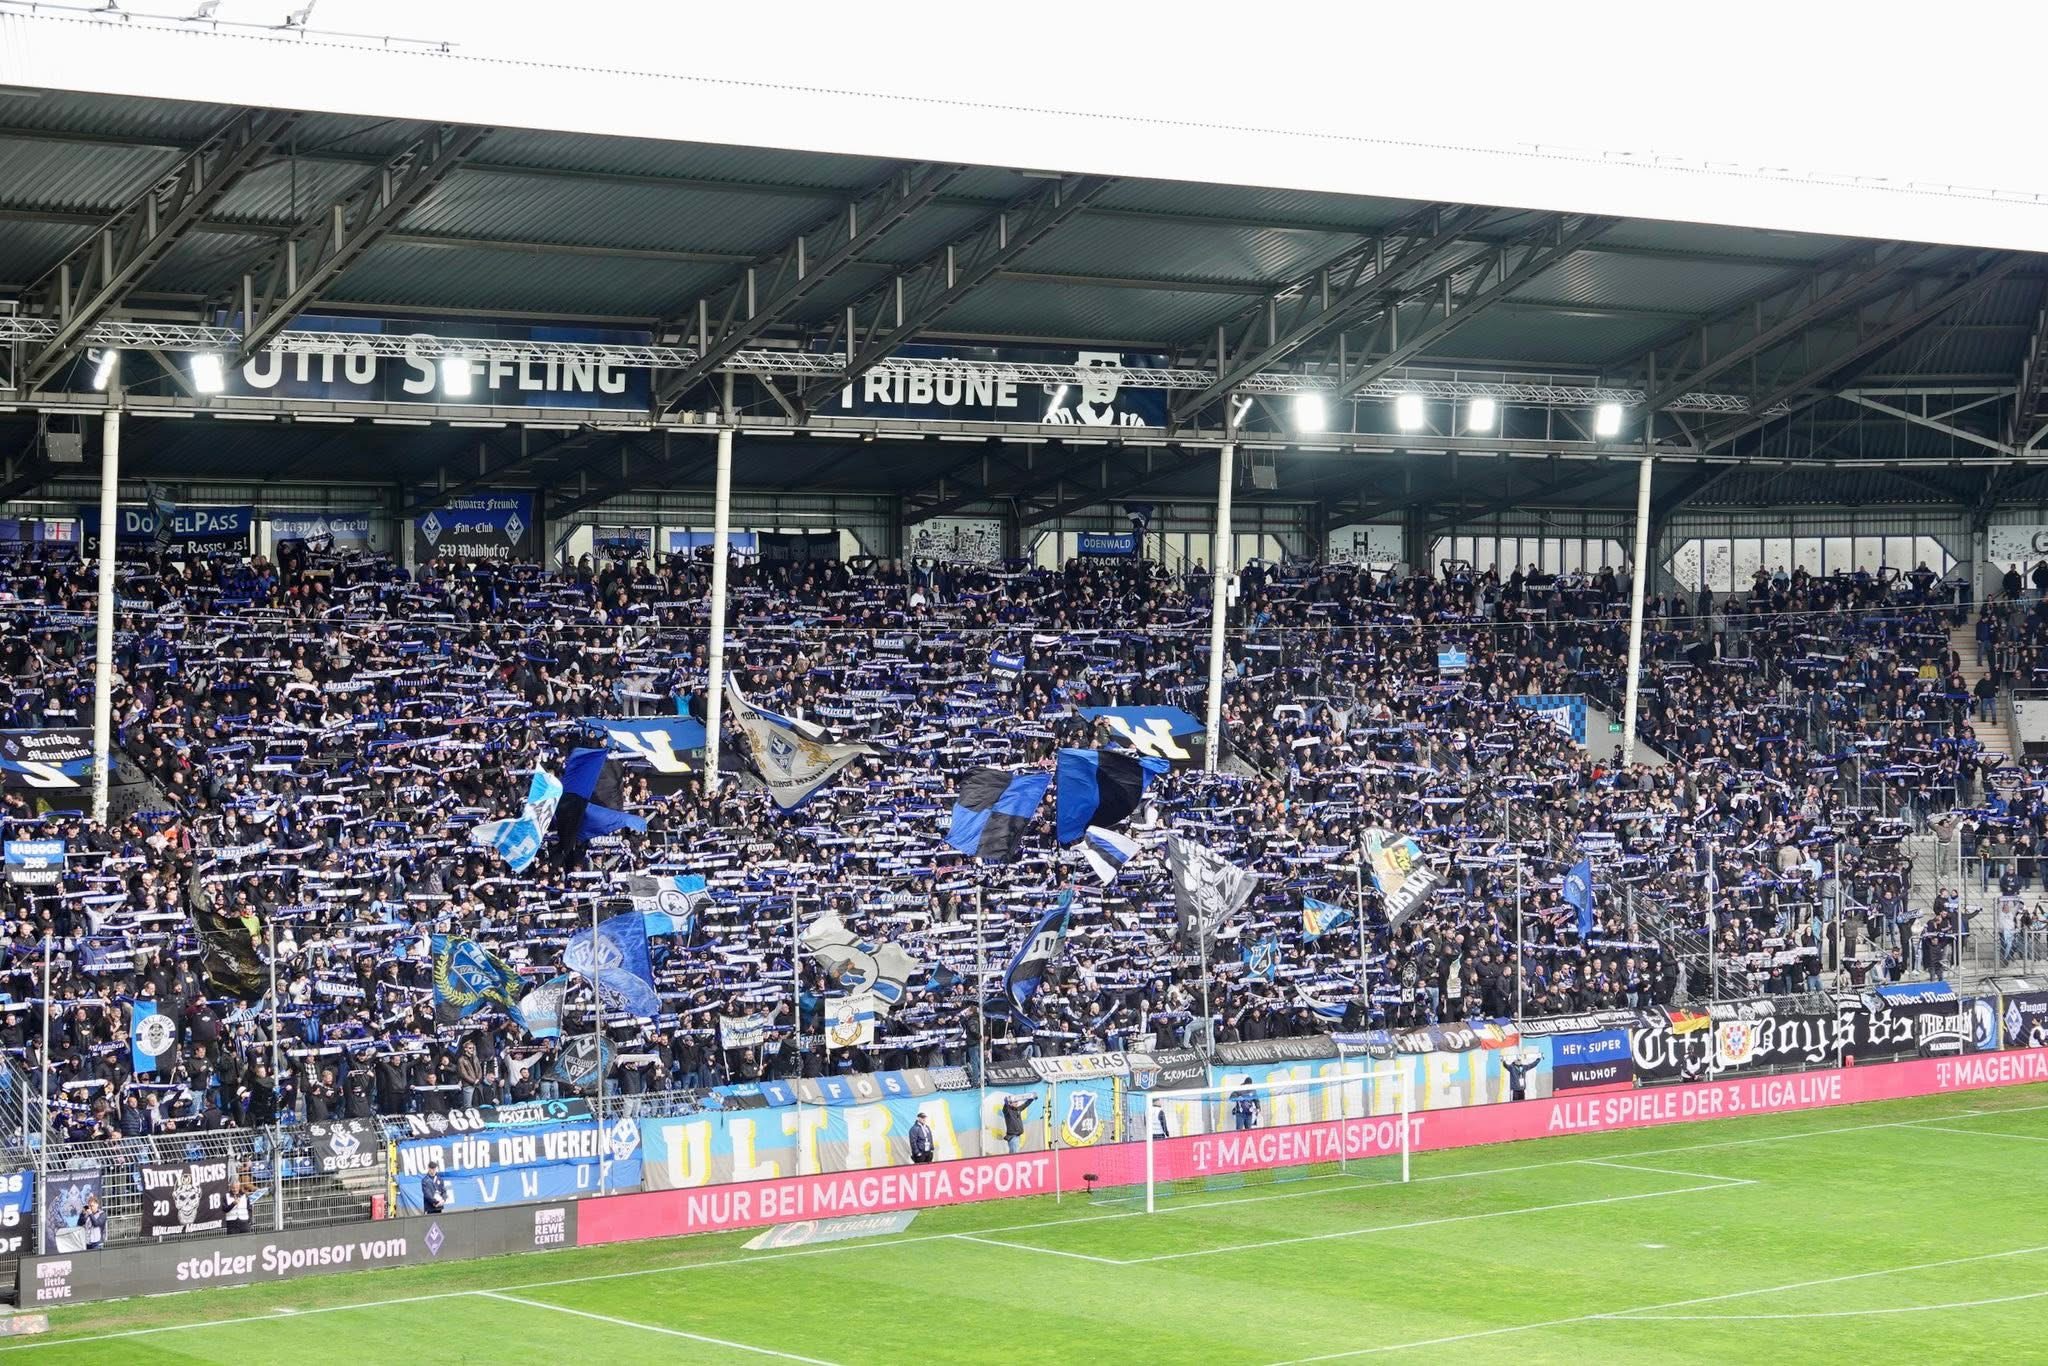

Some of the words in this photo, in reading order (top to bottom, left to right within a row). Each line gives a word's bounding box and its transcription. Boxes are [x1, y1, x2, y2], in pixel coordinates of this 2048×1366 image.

[1083, 538, 1131, 549] ODENWALD
[20, 733, 81, 748] Barrikade
[26, 748, 92, 761] Mannheim
[11, 871, 60, 883] WALDHOF
[1919, 1013, 1944, 1041] THE
[1563, 1044, 1582, 1055] HEY
[1588, 1040, 1621, 1053] SUPER
[1571, 1067, 1617, 1081] WALDHOF
[1955, 1053, 2048, 1087] MAGENTA
[769, 1071, 926, 1103] TIFOSI
[1549, 1100, 1600, 1131] ALLE
[1605, 1093, 1677, 1125] SPIELE
[1682, 1087, 1724, 1117] DER
[1728, 1085, 1747, 1113] 3.
[1751, 1078, 1796, 1109] LIGA
[1801, 1075, 1841, 1103] LIVE
[401, 1144, 446, 1177] NUR
[452, 1135, 491, 1171] FÜR
[499, 1134, 538, 1166] DEN
[543, 1127, 613, 1161] VEREIN
[142, 1168, 184, 1190] DIRTY
[190, 1163, 226, 1187] DICKS
[688, 1190, 759, 1227] NUR
[760, 1183, 804, 1218] BEI
[814, 1168, 954, 1214] MAGENTA
[959, 1158, 1049, 1198] SPORT
[153, 1200, 170, 1216] 20
[208, 1193, 221, 1210] 18
[535, 1222, 565, 1236] REWE
[534, 1233, 565, 1245] CENTER
[176, 1251, 256, 1281] stolzer
[262, 1244, 356, 1276] Sponsor
[360, 1238, 407, 1261] vom
[44, 1277, 66, 1288] little
[36, 1285, 72, 1300] REWE
